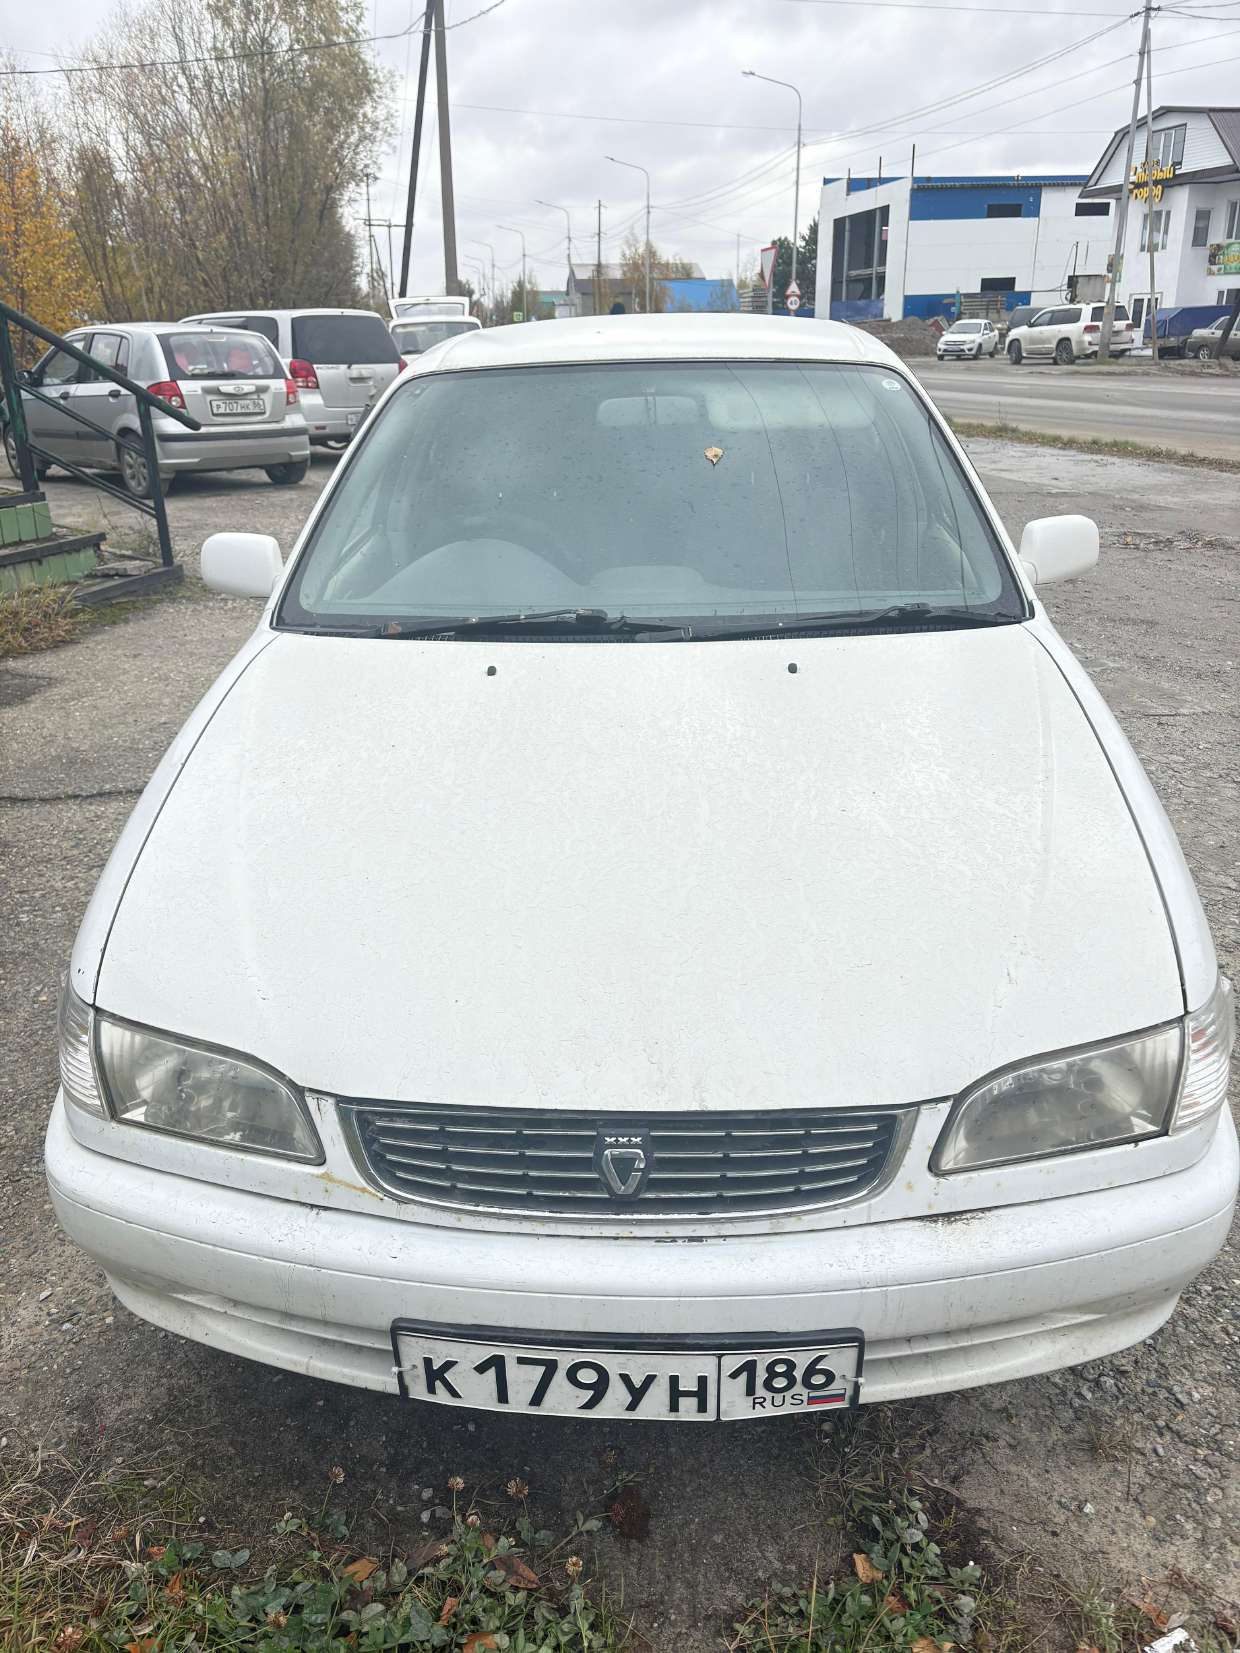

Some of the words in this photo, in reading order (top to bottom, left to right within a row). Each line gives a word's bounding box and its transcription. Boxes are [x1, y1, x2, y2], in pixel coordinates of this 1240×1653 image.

[422, 1353, 708, 1414] К179УН
[728, 1354, 836, 1397] 186
[752, 1393, 804, 1411] RUS
